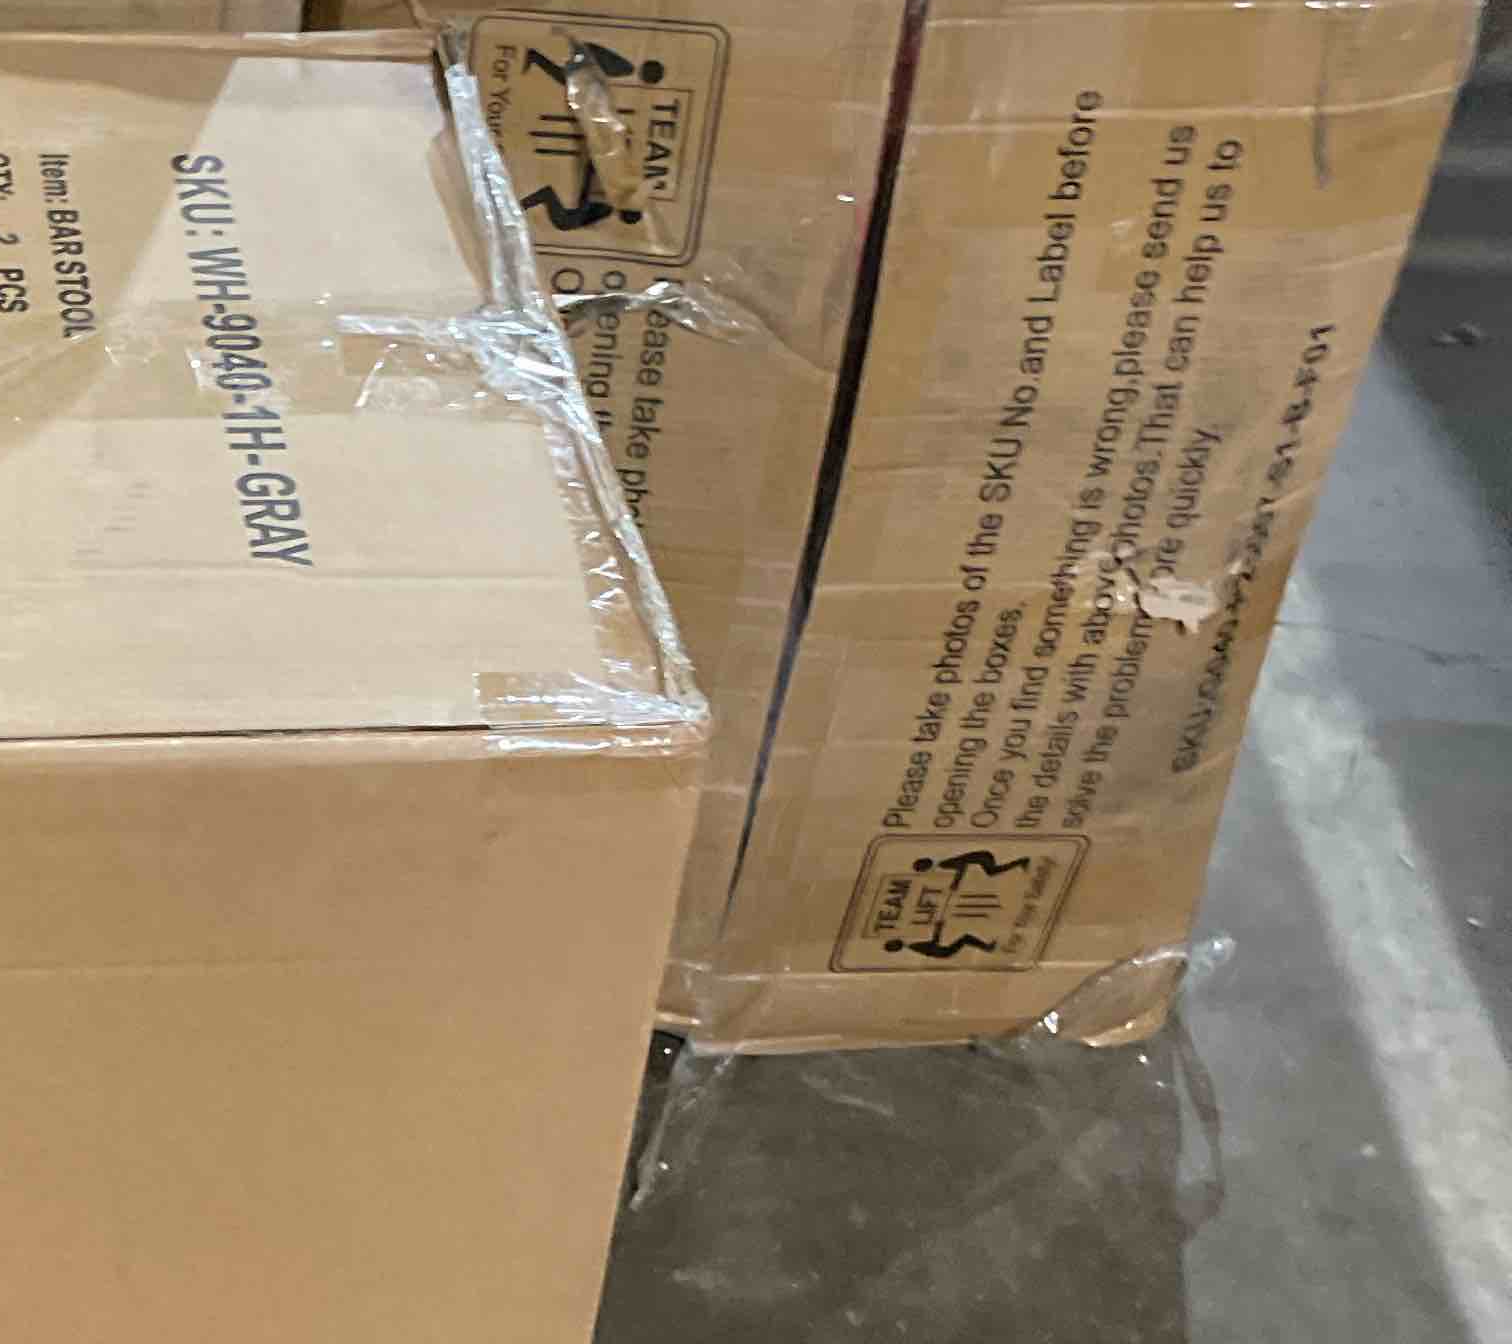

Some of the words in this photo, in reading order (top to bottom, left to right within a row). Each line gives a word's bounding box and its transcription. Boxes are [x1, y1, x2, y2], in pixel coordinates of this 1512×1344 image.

[1050, 89, 1104, 201] before
[1167, 124, 1199, 165] us
[1205, 138, 1245, 171] to
[40, 153, 71, 204] Item:
[170, 153, 236, 237] SKU:
[1201, 182, 1234, 225] us
[1142, 178, 1182, 259] send
[1026, 210, 1076, 304] Label
[1173, 234, 1224, 306] help
[588, 270, 626, 398] oening
[1164, 314, 1202, 376] can
[187, 247, 313, 567] WH-9040-1H-GRAY
[626, 397, 664, 459] take
[978, 437, 1023, 503] SKU
[1079, 486, 1105, 509] is
[965, 512, 1005, 558] the
[960, 564, 989, 592] of
[1034, 520, 1102, 659] something
[1080, 555, 1119, 647] above
[931, 599, 982, 685] photos
[1008, 666, 1050, 711] find
[1063, 651, 1098, 704] with
[910, 692, 951, 743] take
[960, 691, 996, 730] the
[998, 719, 1032, 761] you
[1035, 709, 1080, 789] details
[1061, 768, 1103, 829] solve
[1082, 723, 1119, 766] the
[882, 752, 934, 829] Please
[933, 737, 988, 829] opening
[970, 768, 1016, 829] Once
[1014, 794, 1050, 829] the
[874, 878, 913, 934] TEAM
